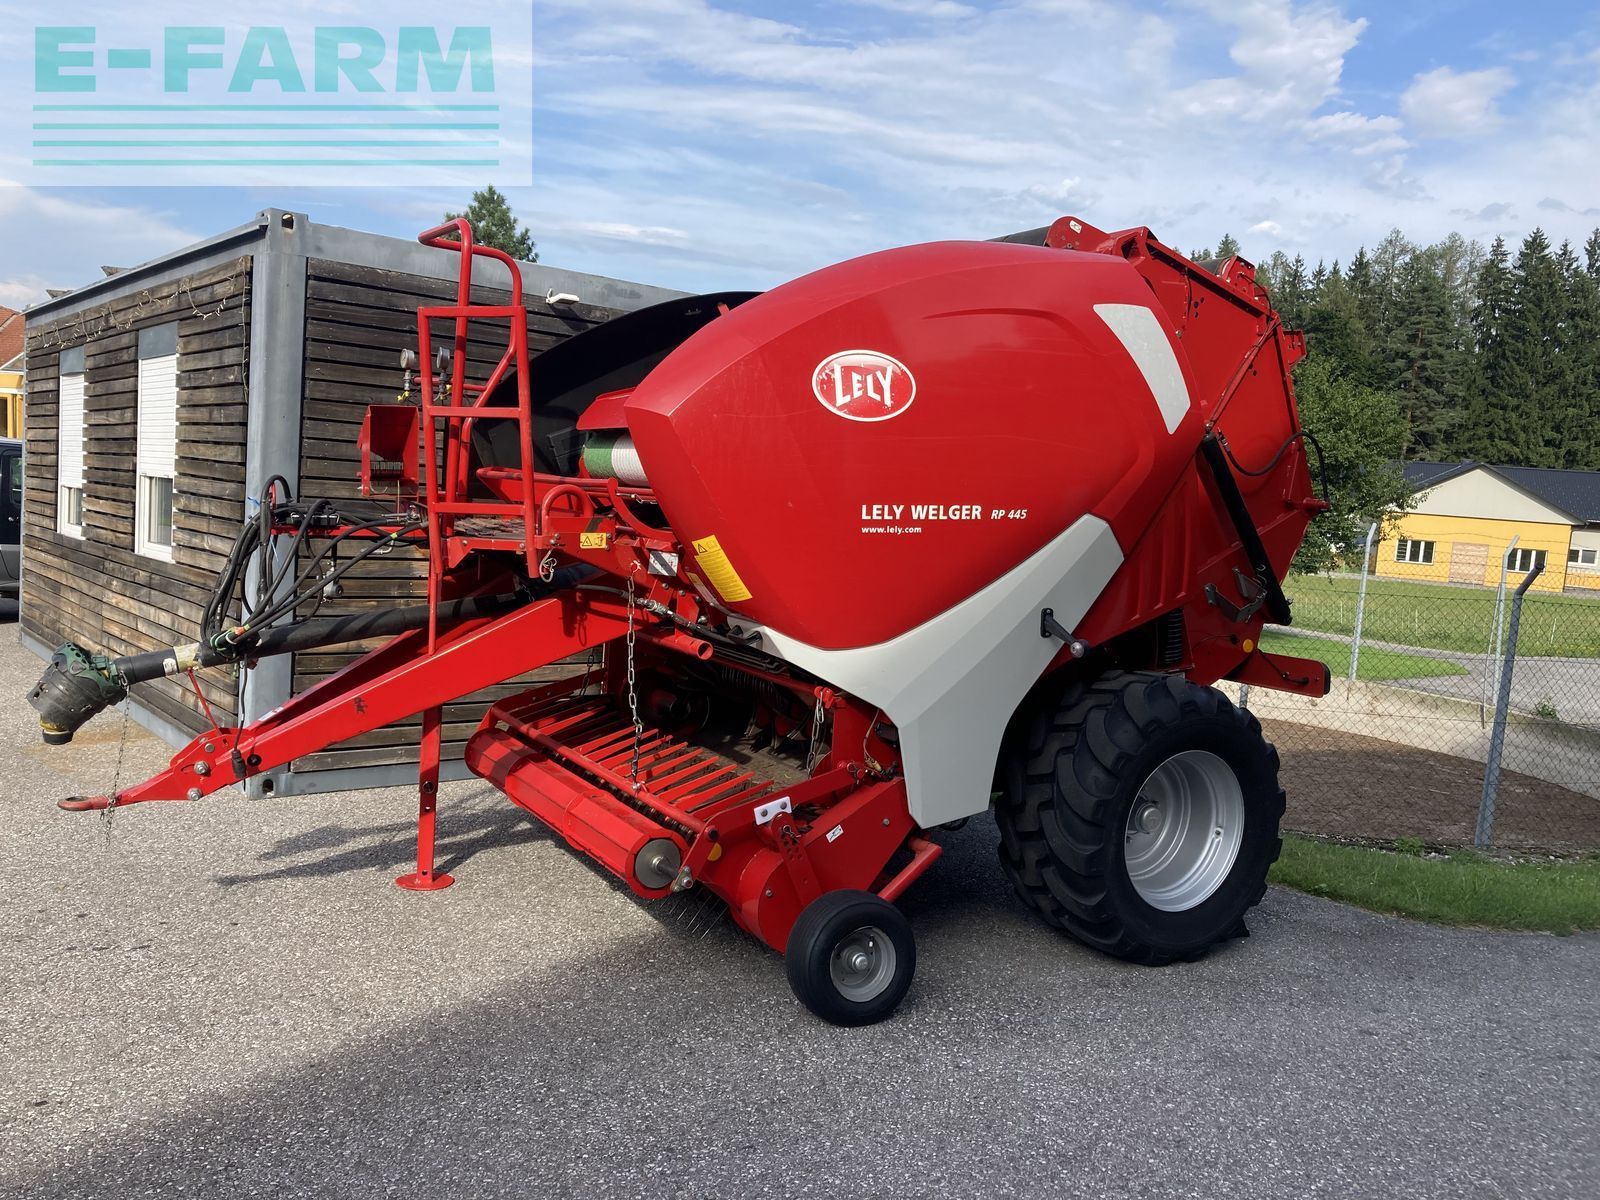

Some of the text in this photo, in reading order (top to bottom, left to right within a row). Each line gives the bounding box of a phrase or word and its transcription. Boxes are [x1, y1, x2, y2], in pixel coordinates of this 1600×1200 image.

[834, 363, 893, 407] LELY
[861, 504, 1028, 520] LELY WELGER RP 445
[861, 525, 922, 535] www.lely.com
